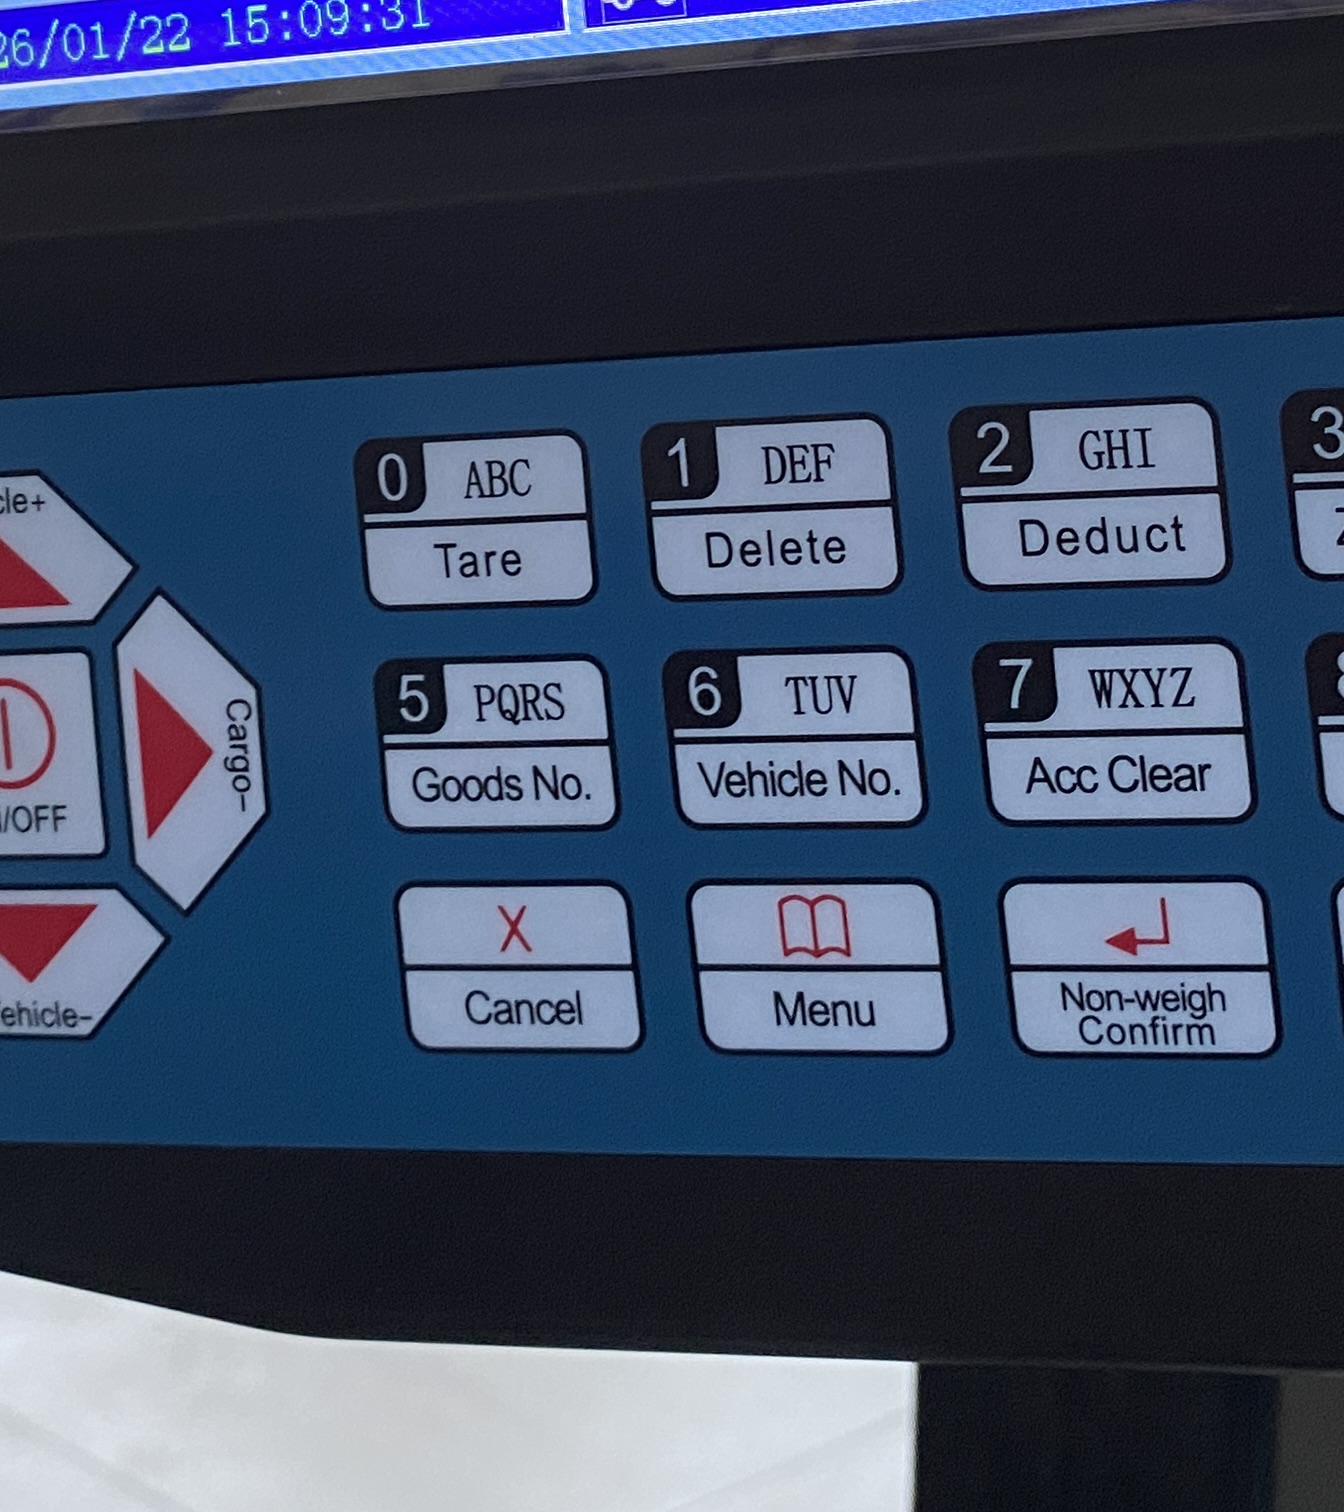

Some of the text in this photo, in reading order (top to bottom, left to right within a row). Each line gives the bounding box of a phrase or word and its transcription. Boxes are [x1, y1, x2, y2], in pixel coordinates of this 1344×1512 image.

[665, 438, 694, 489] 1
[761, 443, 837, 486] DEF
[975, 421, 1015, 475] 2
[1077, 426, 1156, 470] GHI
[375, 451, 410, 502] 0
[464, 459, 533, 501] ABC
[704, 528, 847, 570] Delete
[1018, 515, 1187, 558] Deduct
[432, 542, 523, 580] Tare
[397, 673, 430, 723] 5
[474, 682, 566, 726] PQRS
[687, 665, 723, 717] 6
[783, 674, 858, 717] TUV
[997, 656, 1036, 710] 7
[1087, 667, 1197, 711] WXYZ
[411, 766, 592, 804] Goods No.
[697, 759, 903, 799] Vehicle No.
[1025, 754, 1212, 796] Acc Clear
[464, 989, 585, 1028] Cancel
[772, 992, 877, 1029] Menu
[1060, 981, 1227, 1018] Non-weigh
[1078, 1014, 1216, 1048] Confirm
